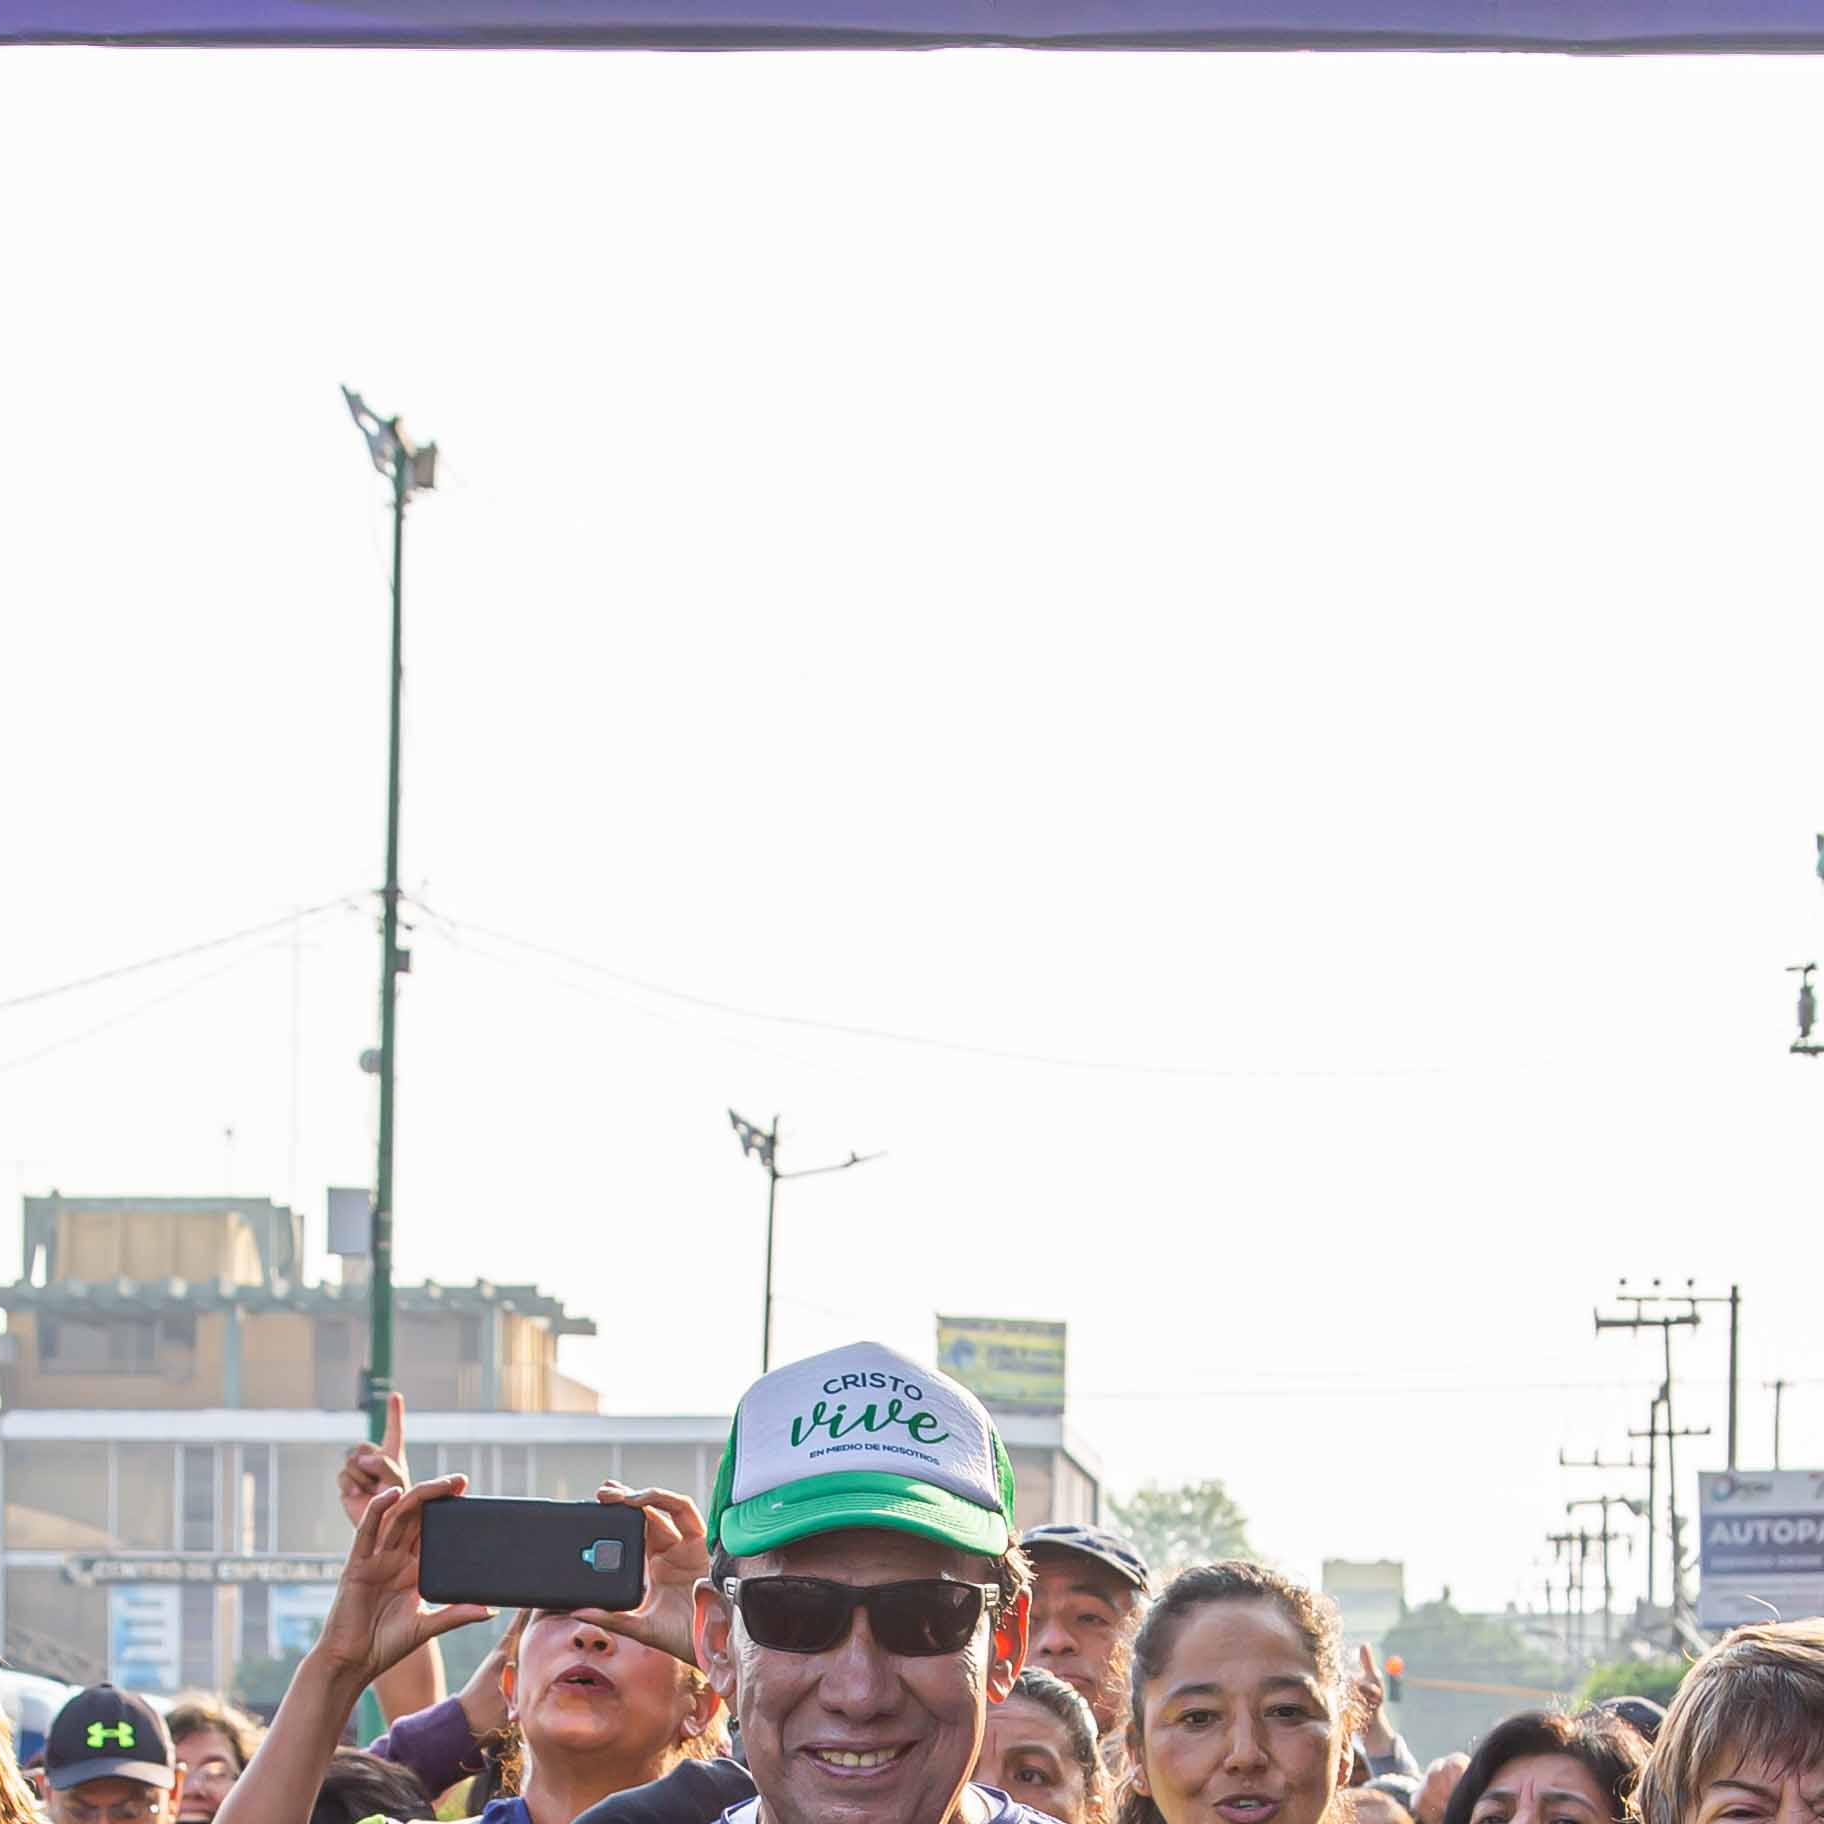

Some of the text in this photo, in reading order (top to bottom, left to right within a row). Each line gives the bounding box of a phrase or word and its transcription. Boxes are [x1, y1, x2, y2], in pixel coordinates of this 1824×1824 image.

[823, 1372, 922, 1400] CRISTO
[791, 1399, 949, 1447] vive
[809, 1450, 825, 1459] EN
[826, 1443, 862, 1452] MEDIO
